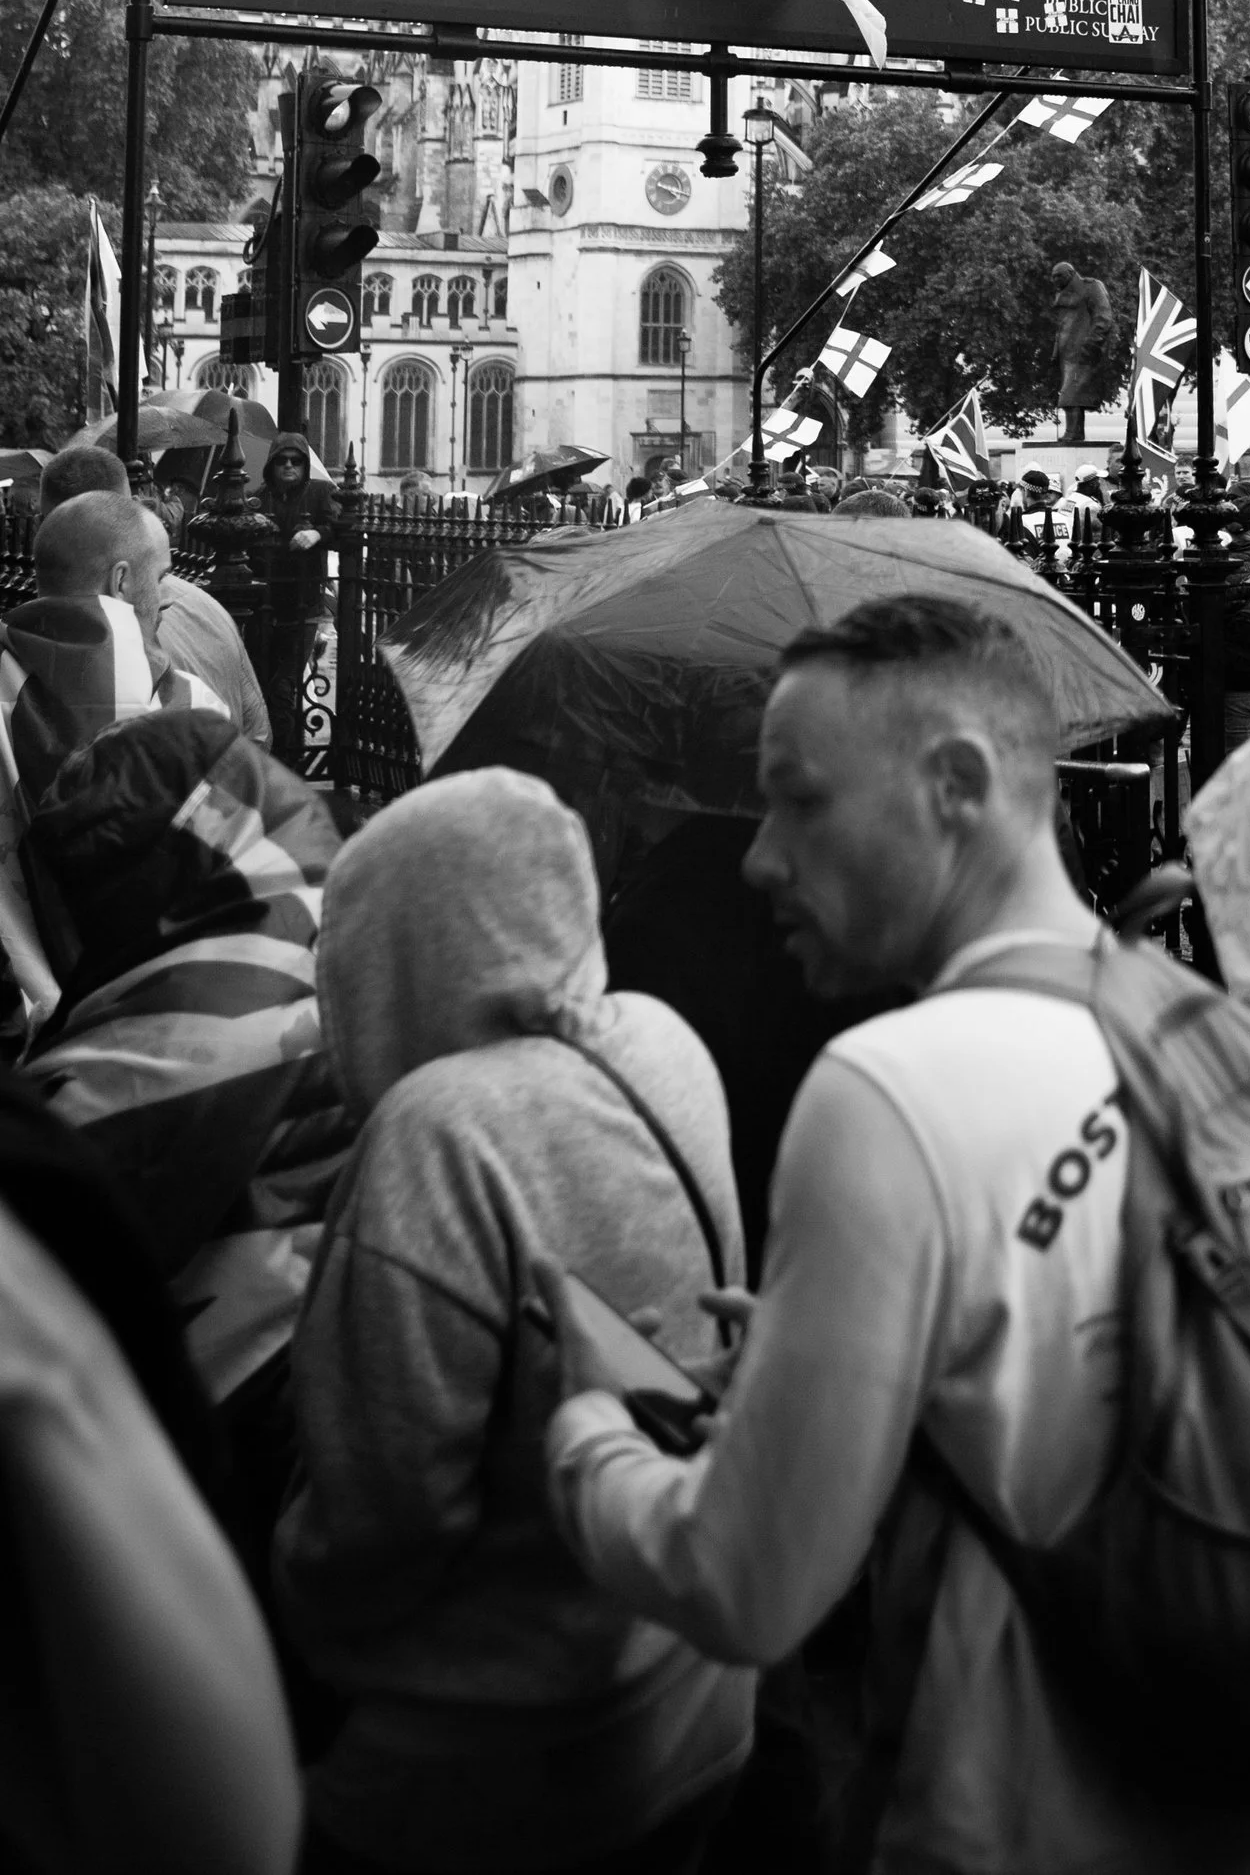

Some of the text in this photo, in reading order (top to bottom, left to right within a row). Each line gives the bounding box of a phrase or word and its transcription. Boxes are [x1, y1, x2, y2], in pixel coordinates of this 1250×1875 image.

[1110, 4, 1139, 24] CHAI
[1092, 21, 1159, 41] SUAY
[1036, 525, 1068, 538] PICE
[1016, 1095, 1118, 1253] BOS
